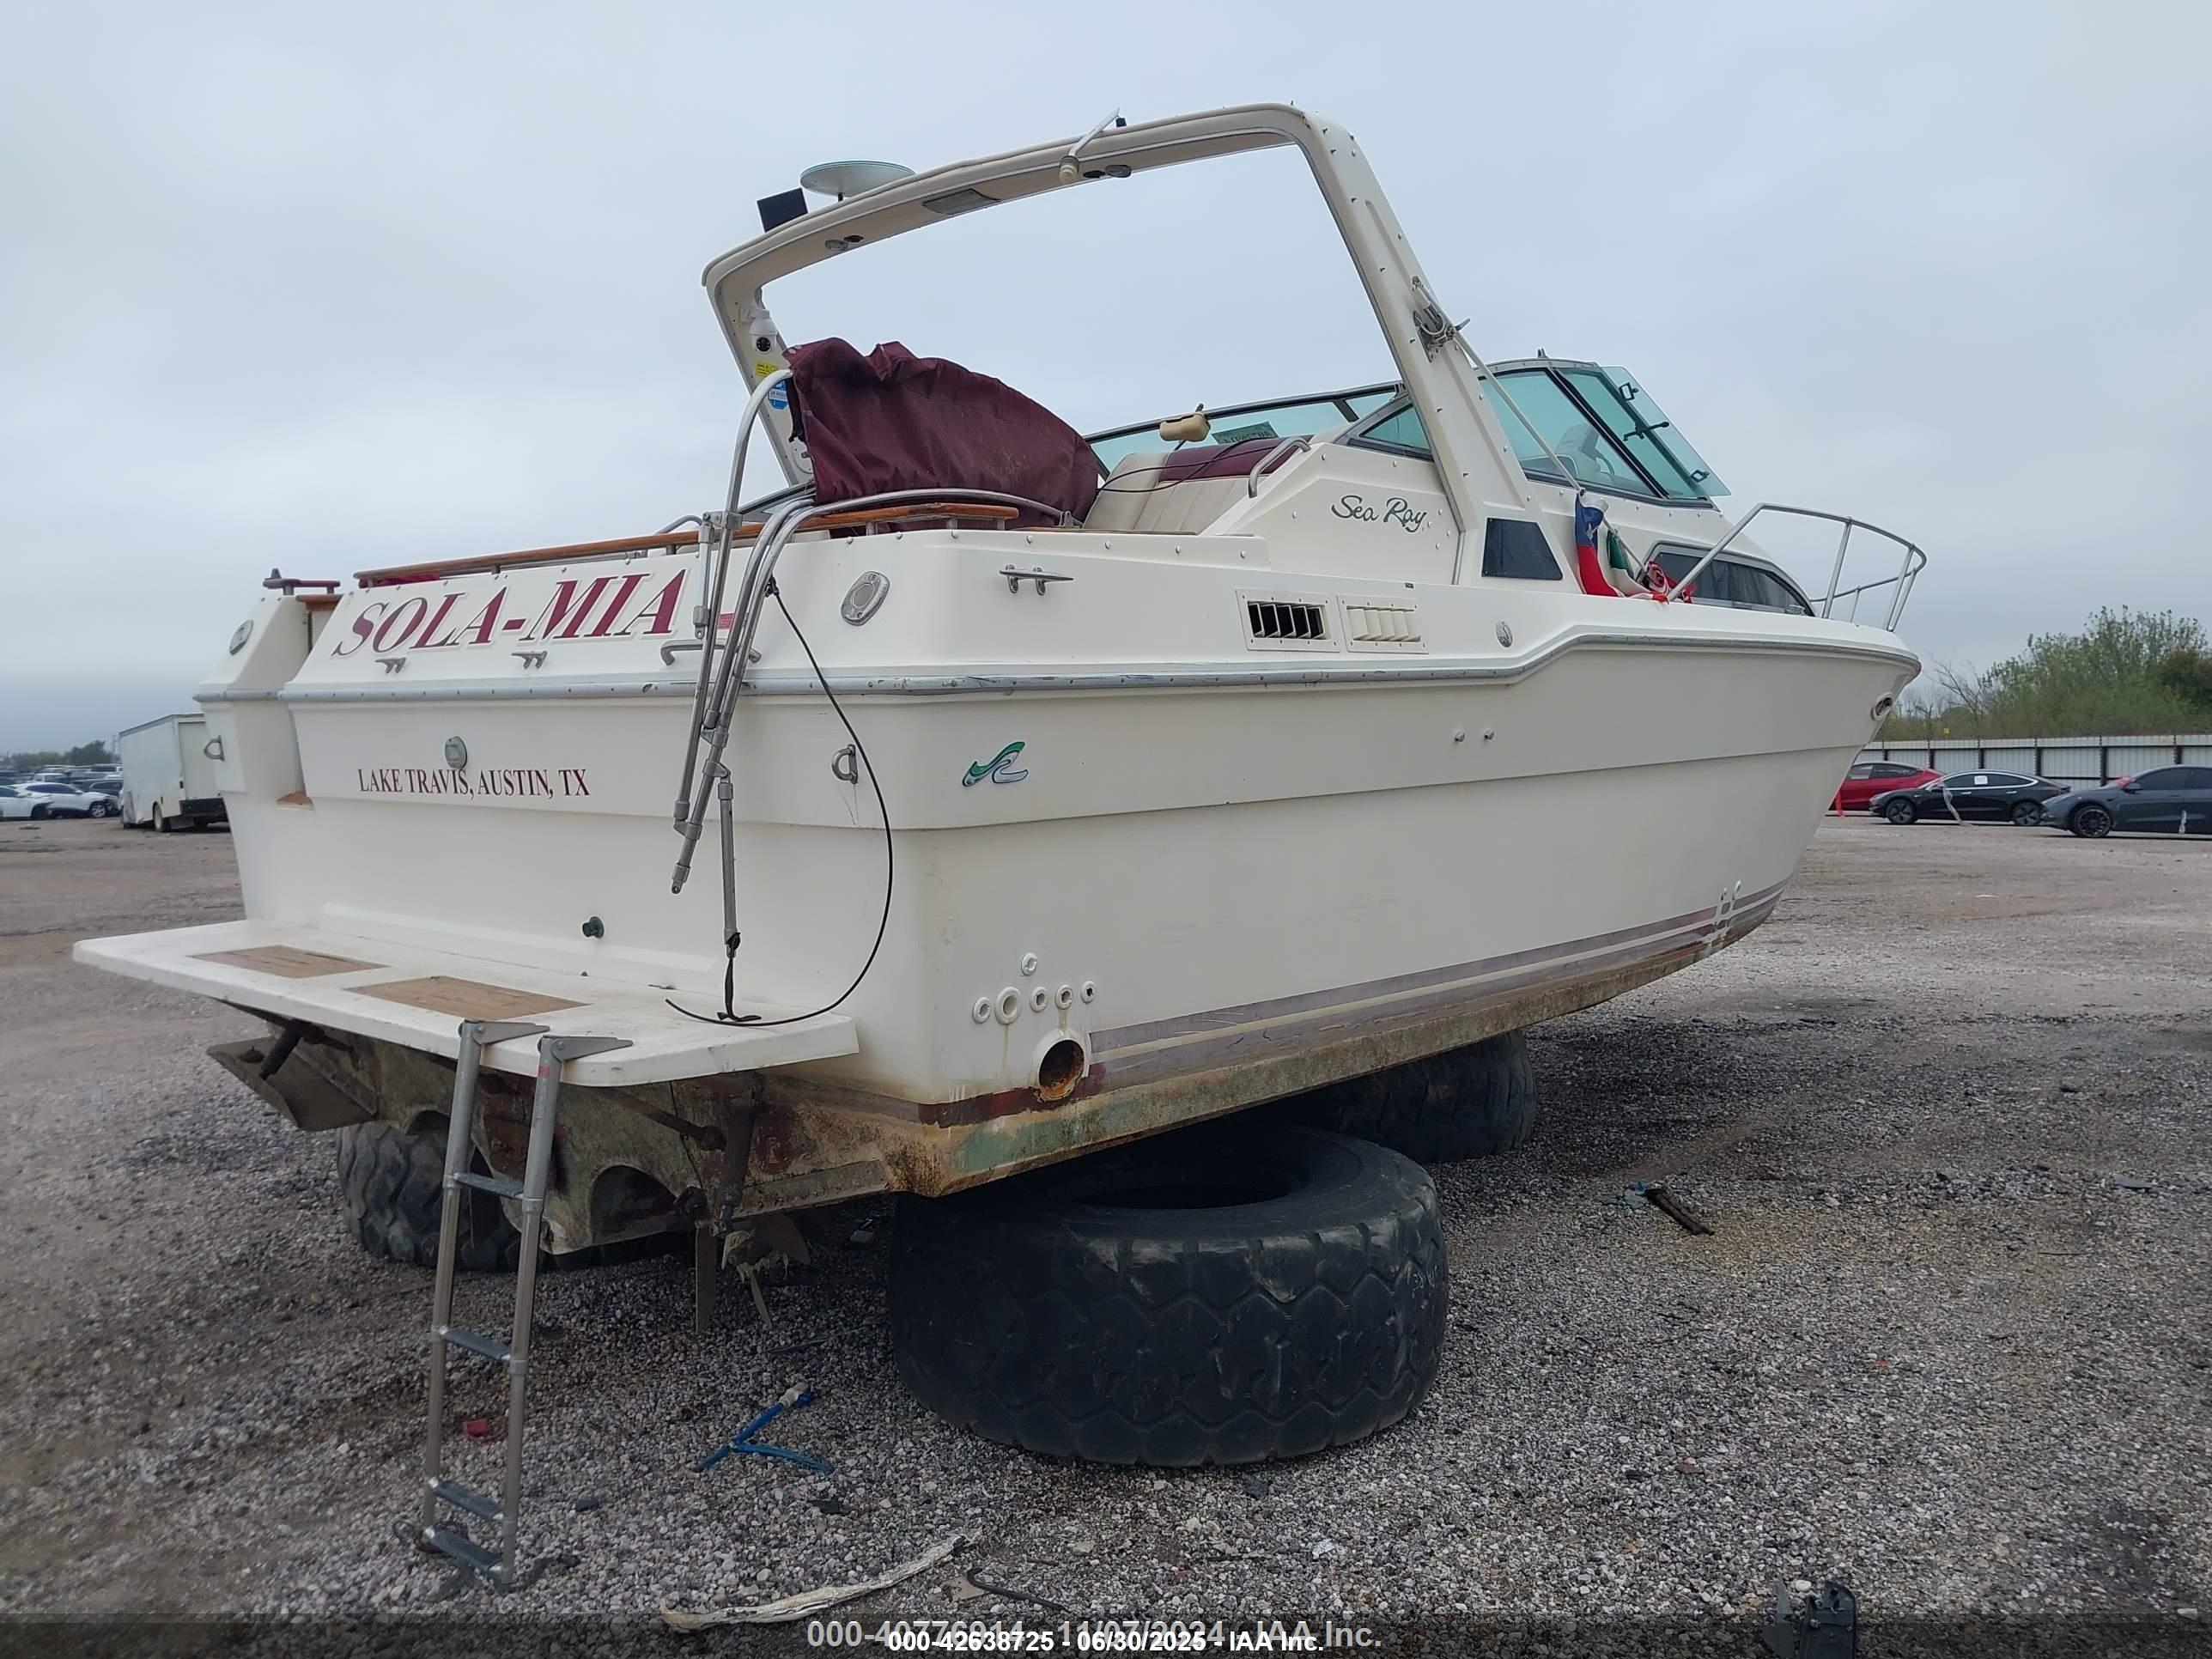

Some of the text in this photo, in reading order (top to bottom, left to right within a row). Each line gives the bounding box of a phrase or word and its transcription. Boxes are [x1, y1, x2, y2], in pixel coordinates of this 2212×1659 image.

[1331, 495, 1427, 533] Sea Ray
[331, 568, 686, 657] SOLA-MIA
[357, 769, 591, 800] LAKE TRAVIS, AUSTIN, TX
